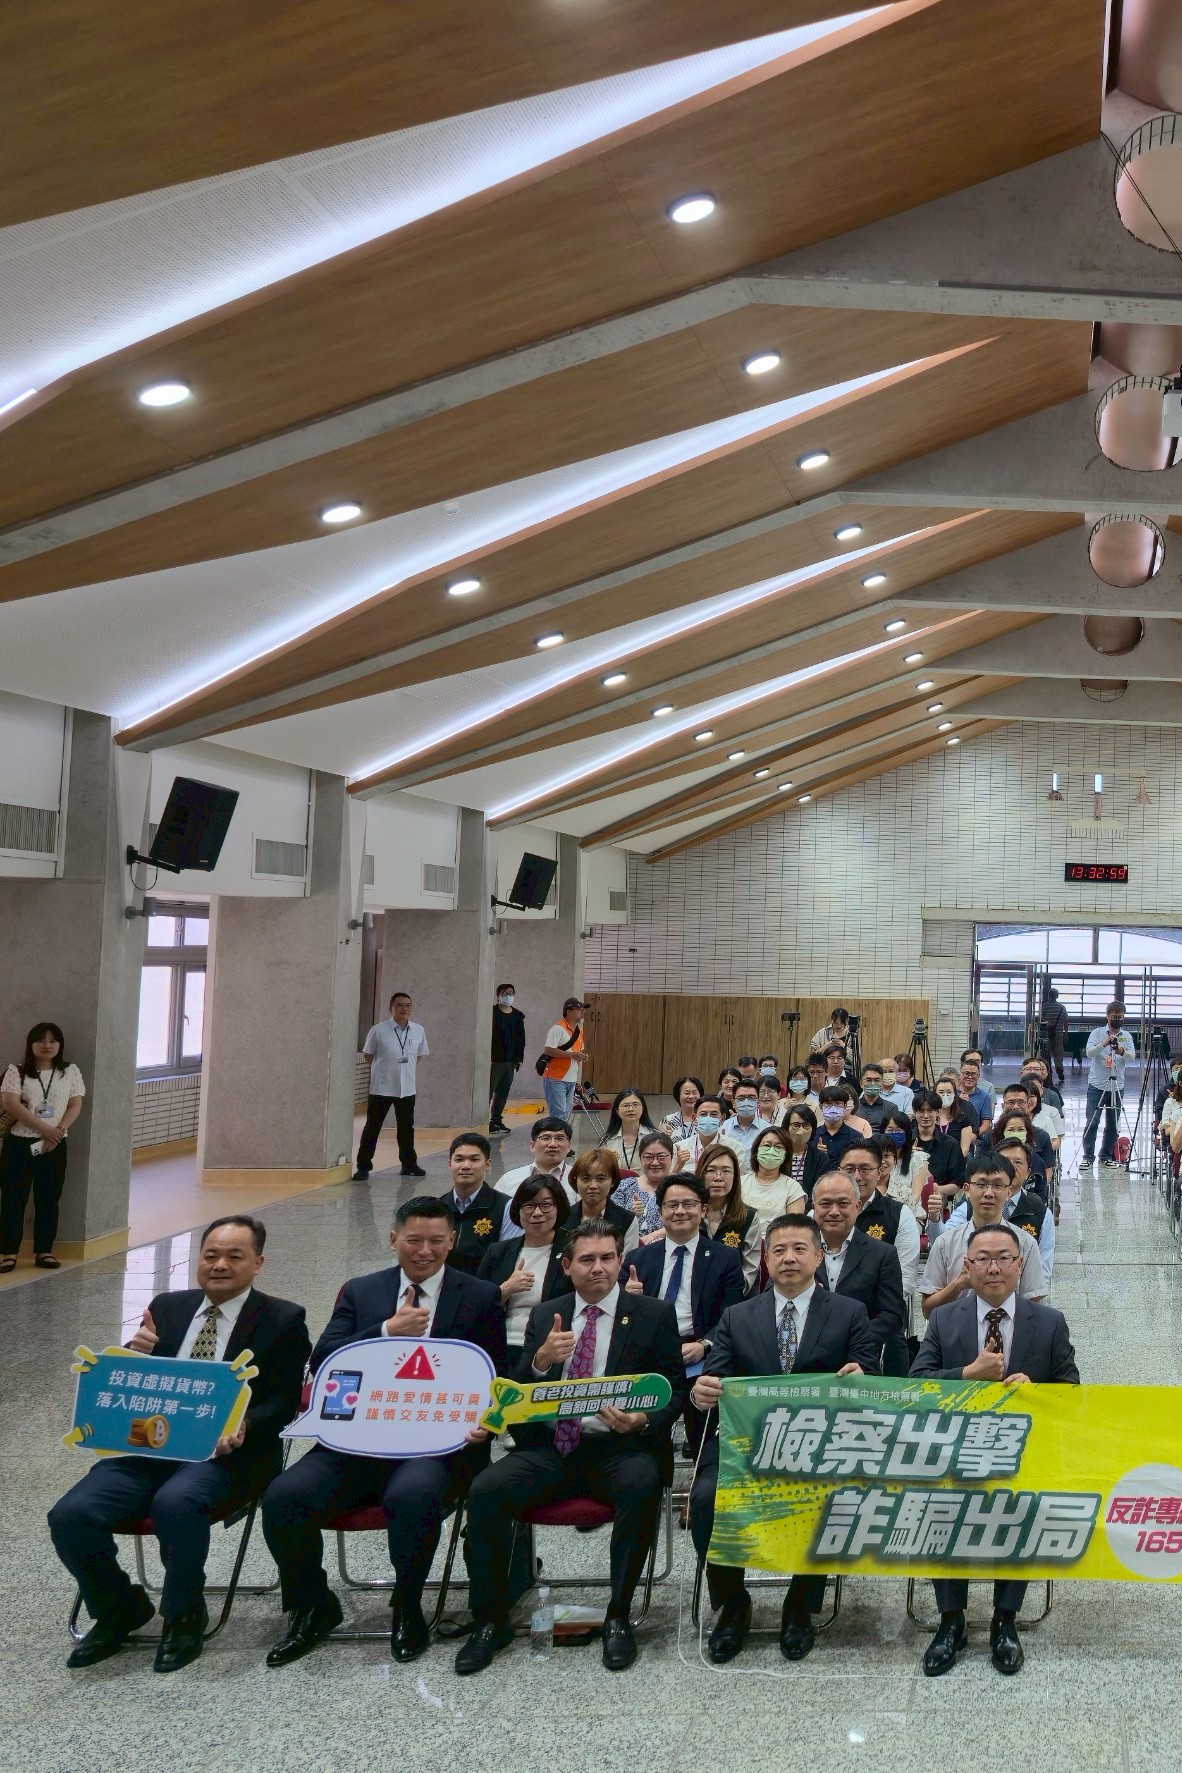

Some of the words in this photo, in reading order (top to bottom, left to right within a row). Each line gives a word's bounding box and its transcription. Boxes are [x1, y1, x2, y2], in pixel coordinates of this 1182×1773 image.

[1069, 866, 1127, 880] 13:32:59
[108, 1369, 216, 1396] 投資虛擬貨幣?
[96, 1392, 217, 1419] 落入陷阱第一步!
[369, 1389, 481, 1406] 網路愛情甚可貴
[365, 1407, 479, 1423] 謹慎交友免受騙
[753, 1407, 1031, 1479] 檢察出擊
[814, 1487, 1099, 1561] 詐騙出局
